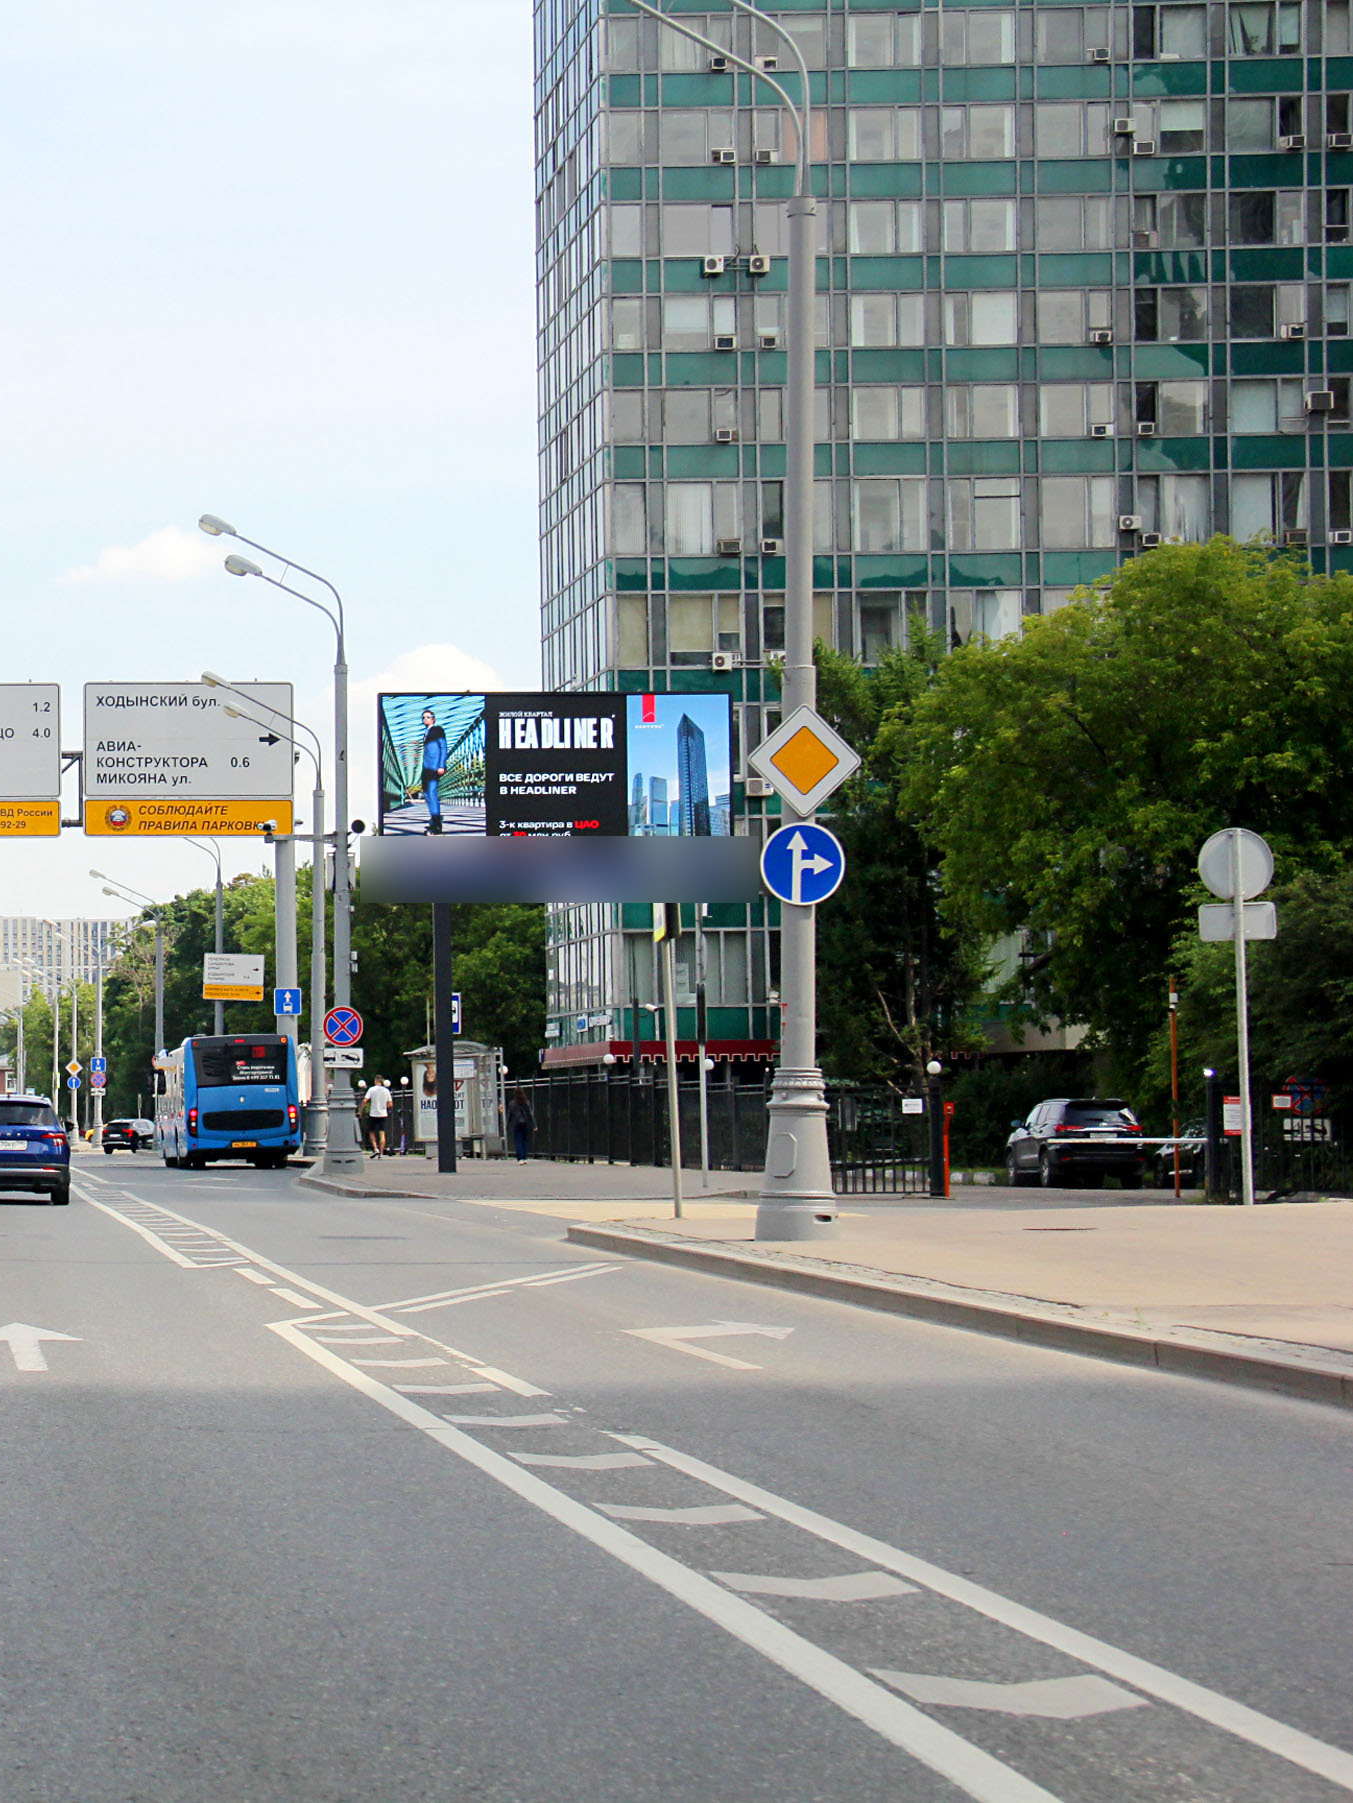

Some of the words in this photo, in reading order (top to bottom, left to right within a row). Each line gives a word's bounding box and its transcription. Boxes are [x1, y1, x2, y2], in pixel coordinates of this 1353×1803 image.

[33, 702, 50, 712] 1.2
[96, 694, 188, 709] ХОДЫНСКИЙ
[192, 695, 220, 709] бул.
[32, 728, 50, 738] 4.0
[499, 718, 613, 748] HEADLINER
[97, 741, 142, 751] АВИА-
[97, 757, 208, 768] КОНСТРУКТОРА
[231, 757, 250, 767] 0.6
[97, 773, 168, 784] МИКОЯНА
[172, 775, 191, 786] ул.
[500, 774, 522, 782] ВСЕ
[525, 773, 573, 784] ДОРОГИ
[576, 773, 614, 783] ВЕДУТ
[511, 786, 576, 794] HEADLINER
[139, 805, 228, 816] СОБЛЮДАЙТЕ
[139, 820, 198, 831] ПРАВИЛА
[202, 820, 265, 830] ПАРКОВК
[518, 822, 564, 830] квартира
[575, 820, 599, 829] ЦАО
